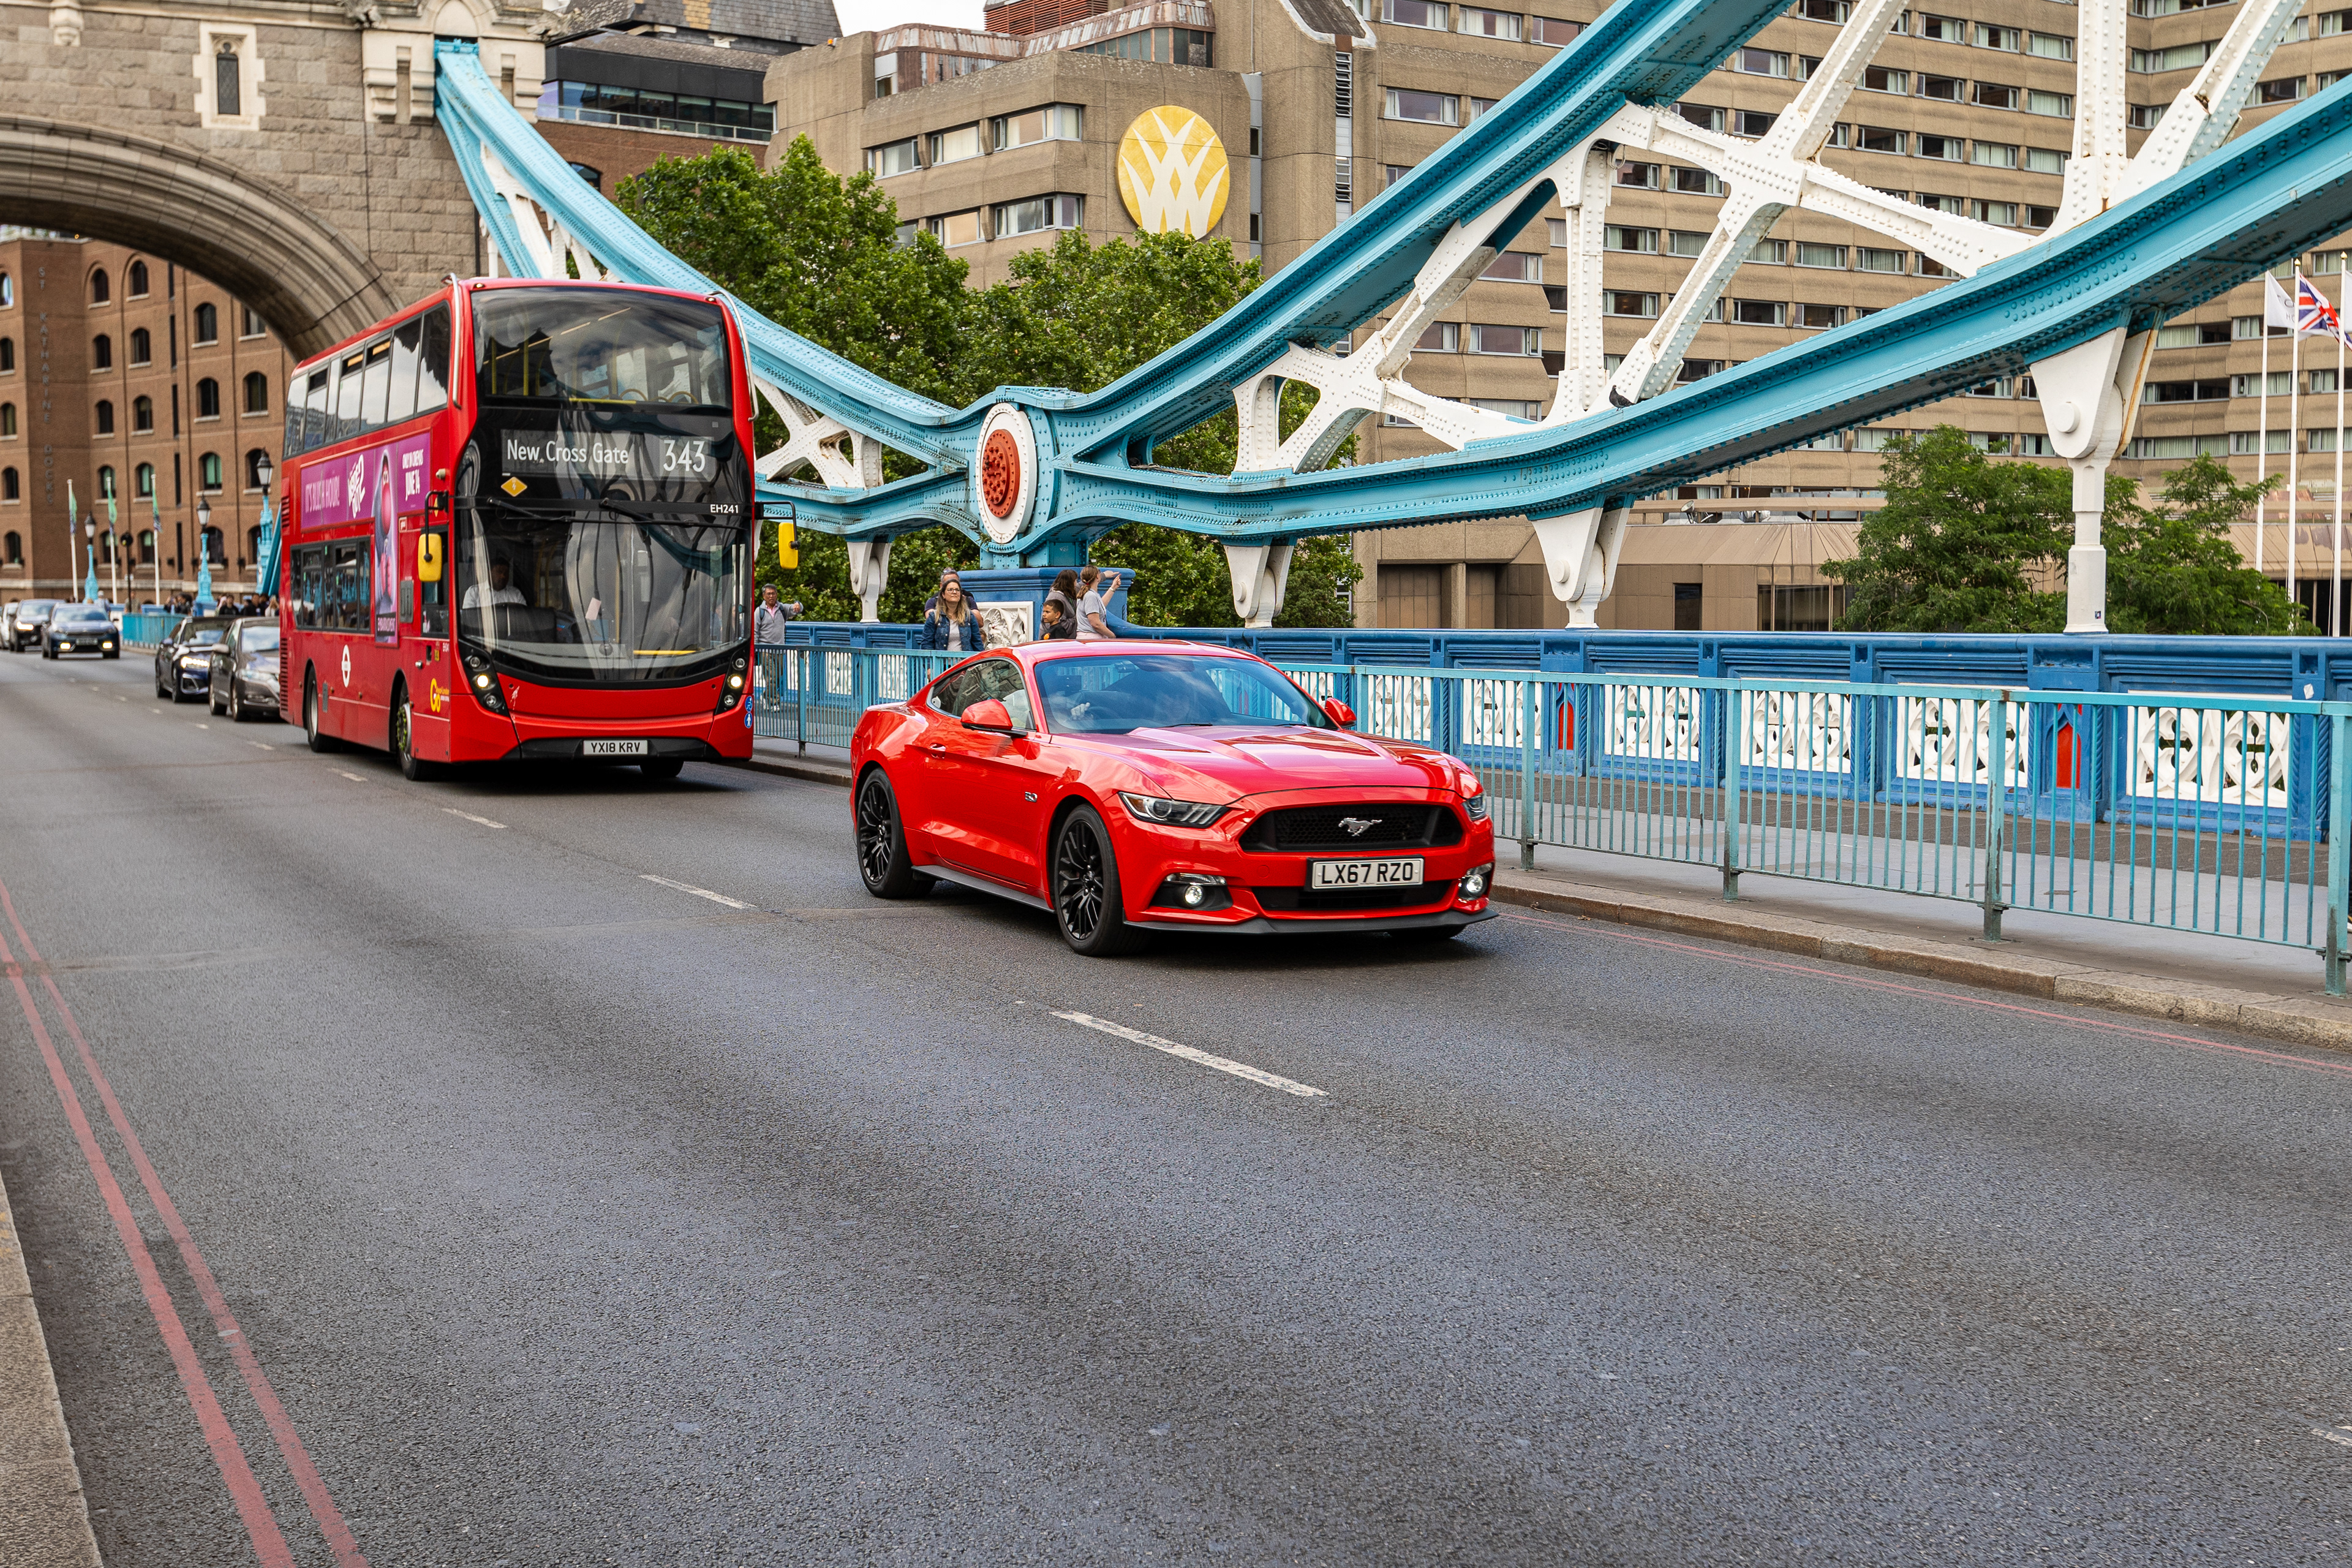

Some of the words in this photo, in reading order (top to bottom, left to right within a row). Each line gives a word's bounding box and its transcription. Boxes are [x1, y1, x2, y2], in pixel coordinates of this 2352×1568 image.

[507, 439, 540, 461] New
[546, 440, 587, 462] Cross
[592, 442, 628, 464] Gate
[663, 439, 706, 472] 343
[710, 503, 739, 514] EH241
[591, 742, 616, 753] YX18
[619, 742, 640, 753] KRV
[1321, 864, 1371, 884] LX67
[1377, 862, 1414, 883] RZO
